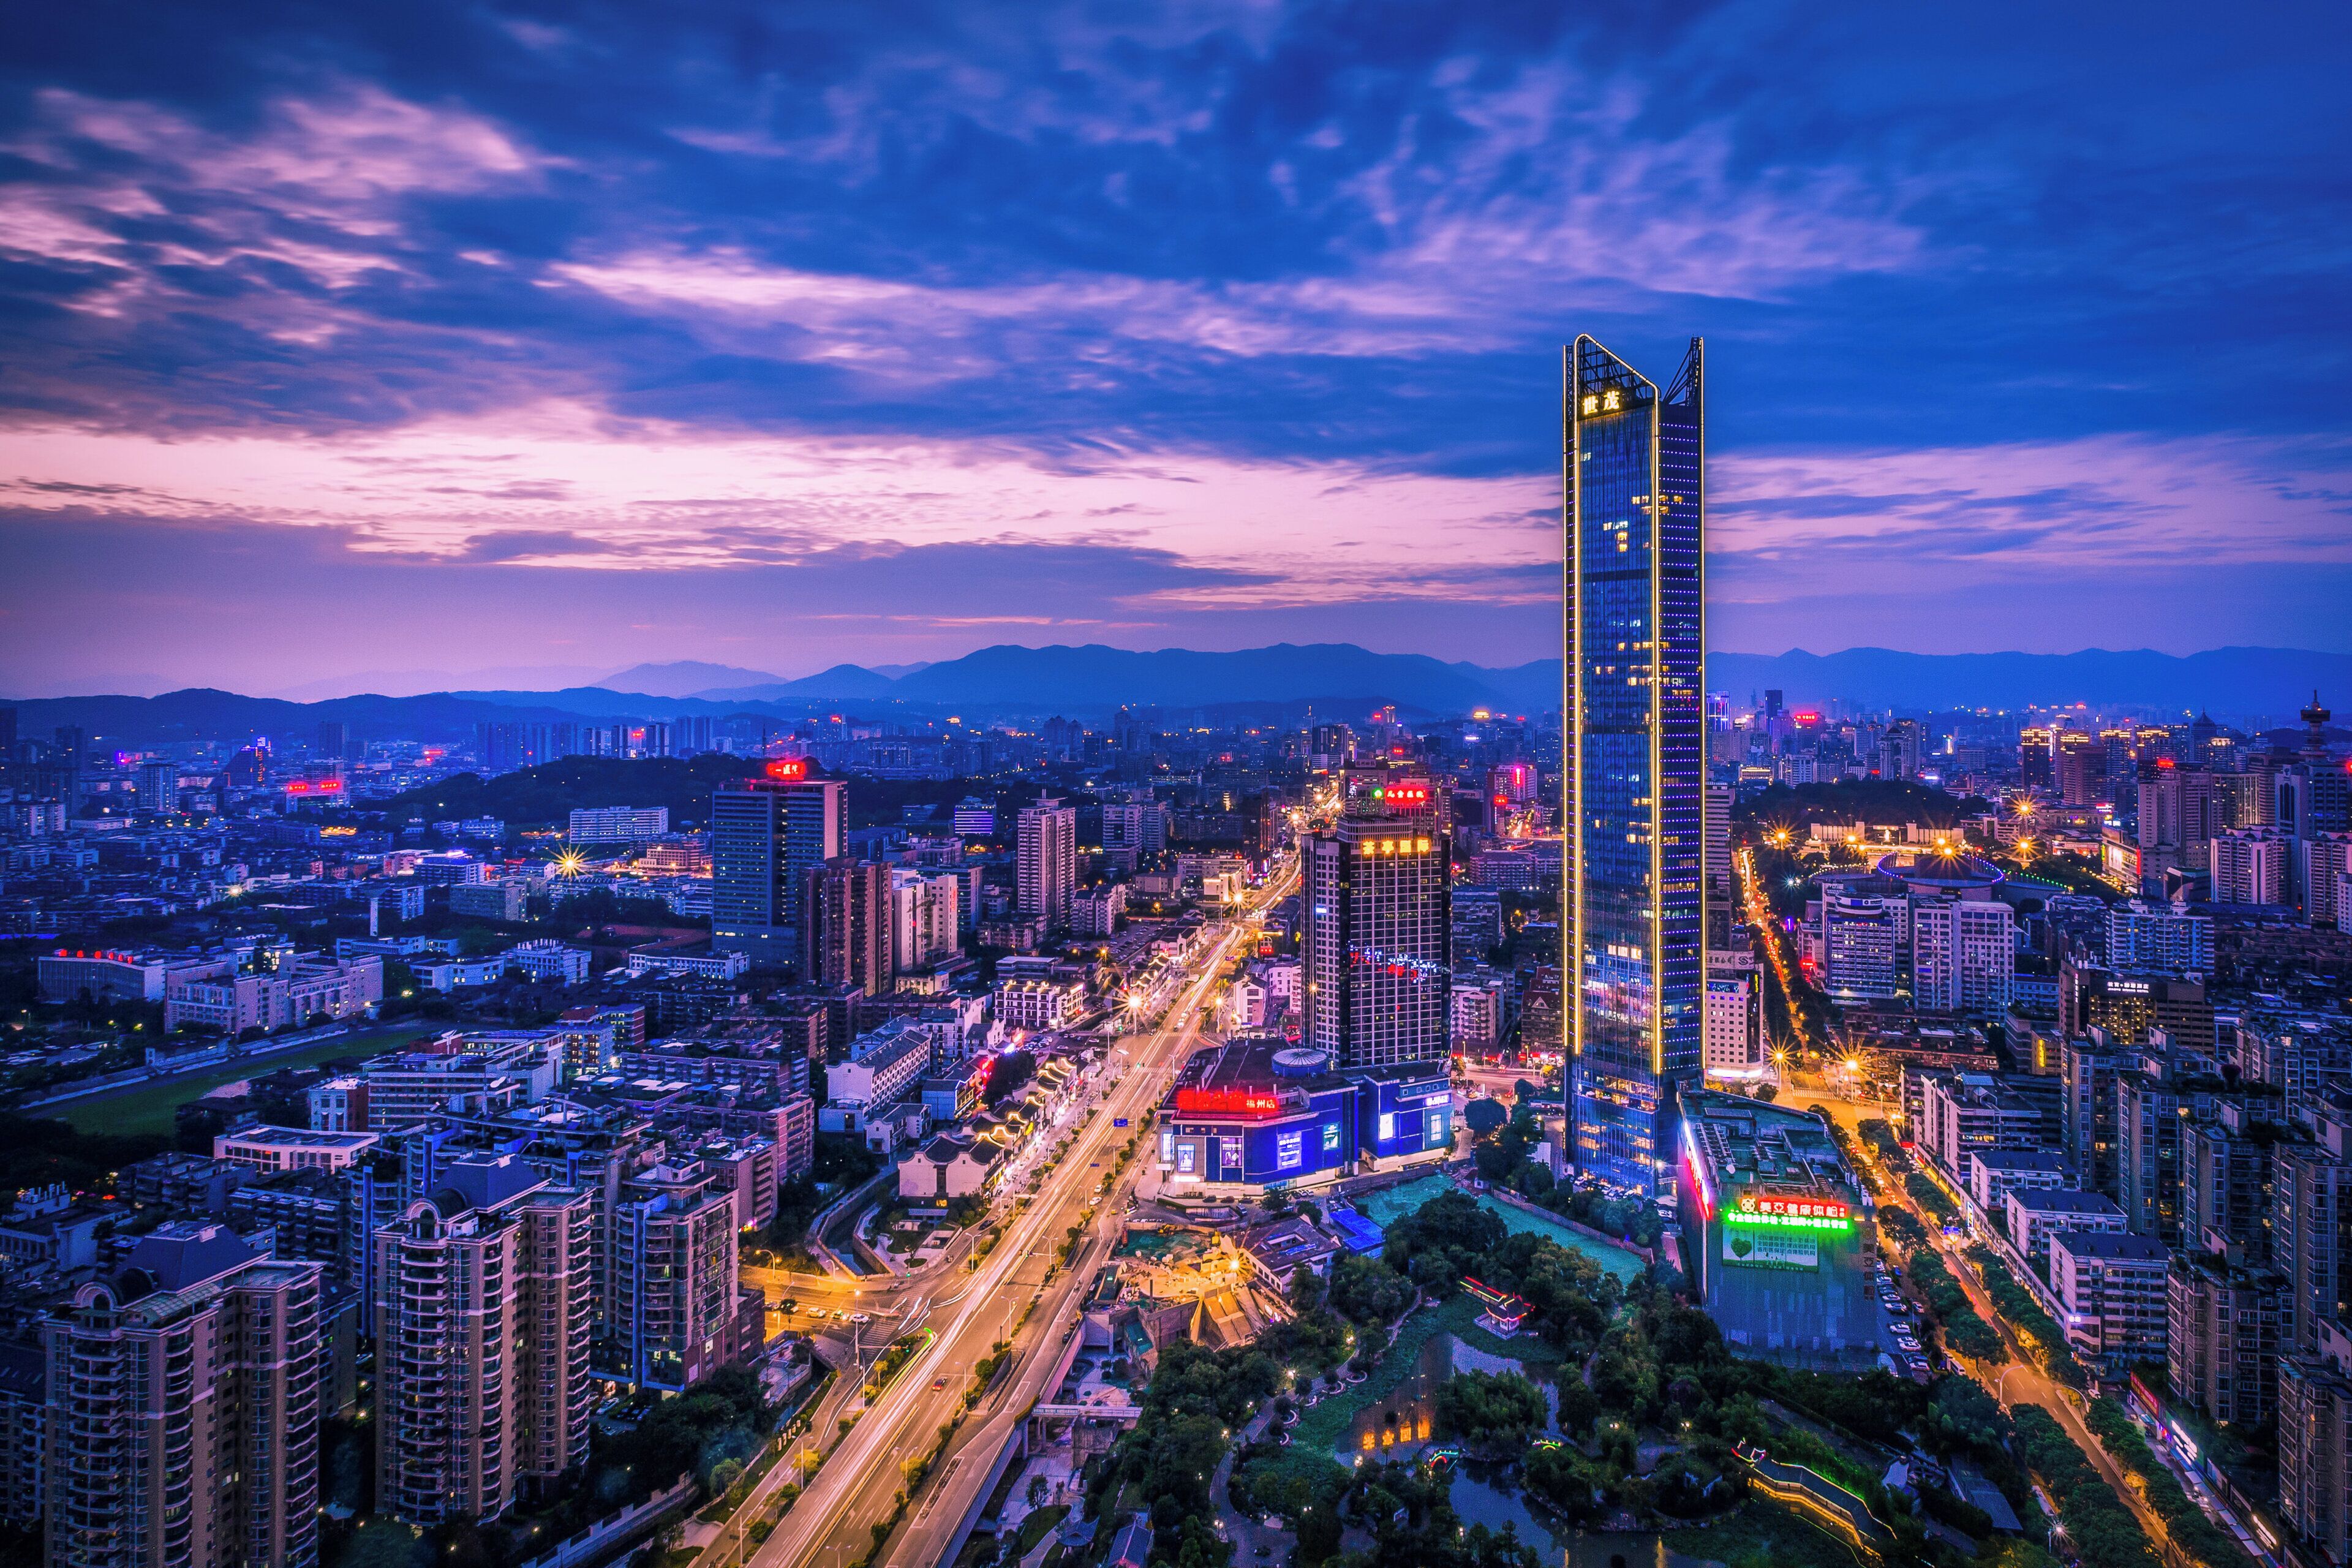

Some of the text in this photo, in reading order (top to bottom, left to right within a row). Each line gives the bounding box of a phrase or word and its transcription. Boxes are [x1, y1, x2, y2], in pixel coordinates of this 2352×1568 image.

[1582, 391, 1621, 415] 世茂
[1362, 839, 1429, 855] 茶亭国际
[1246, 1098, 1276, 1109] 福州店
